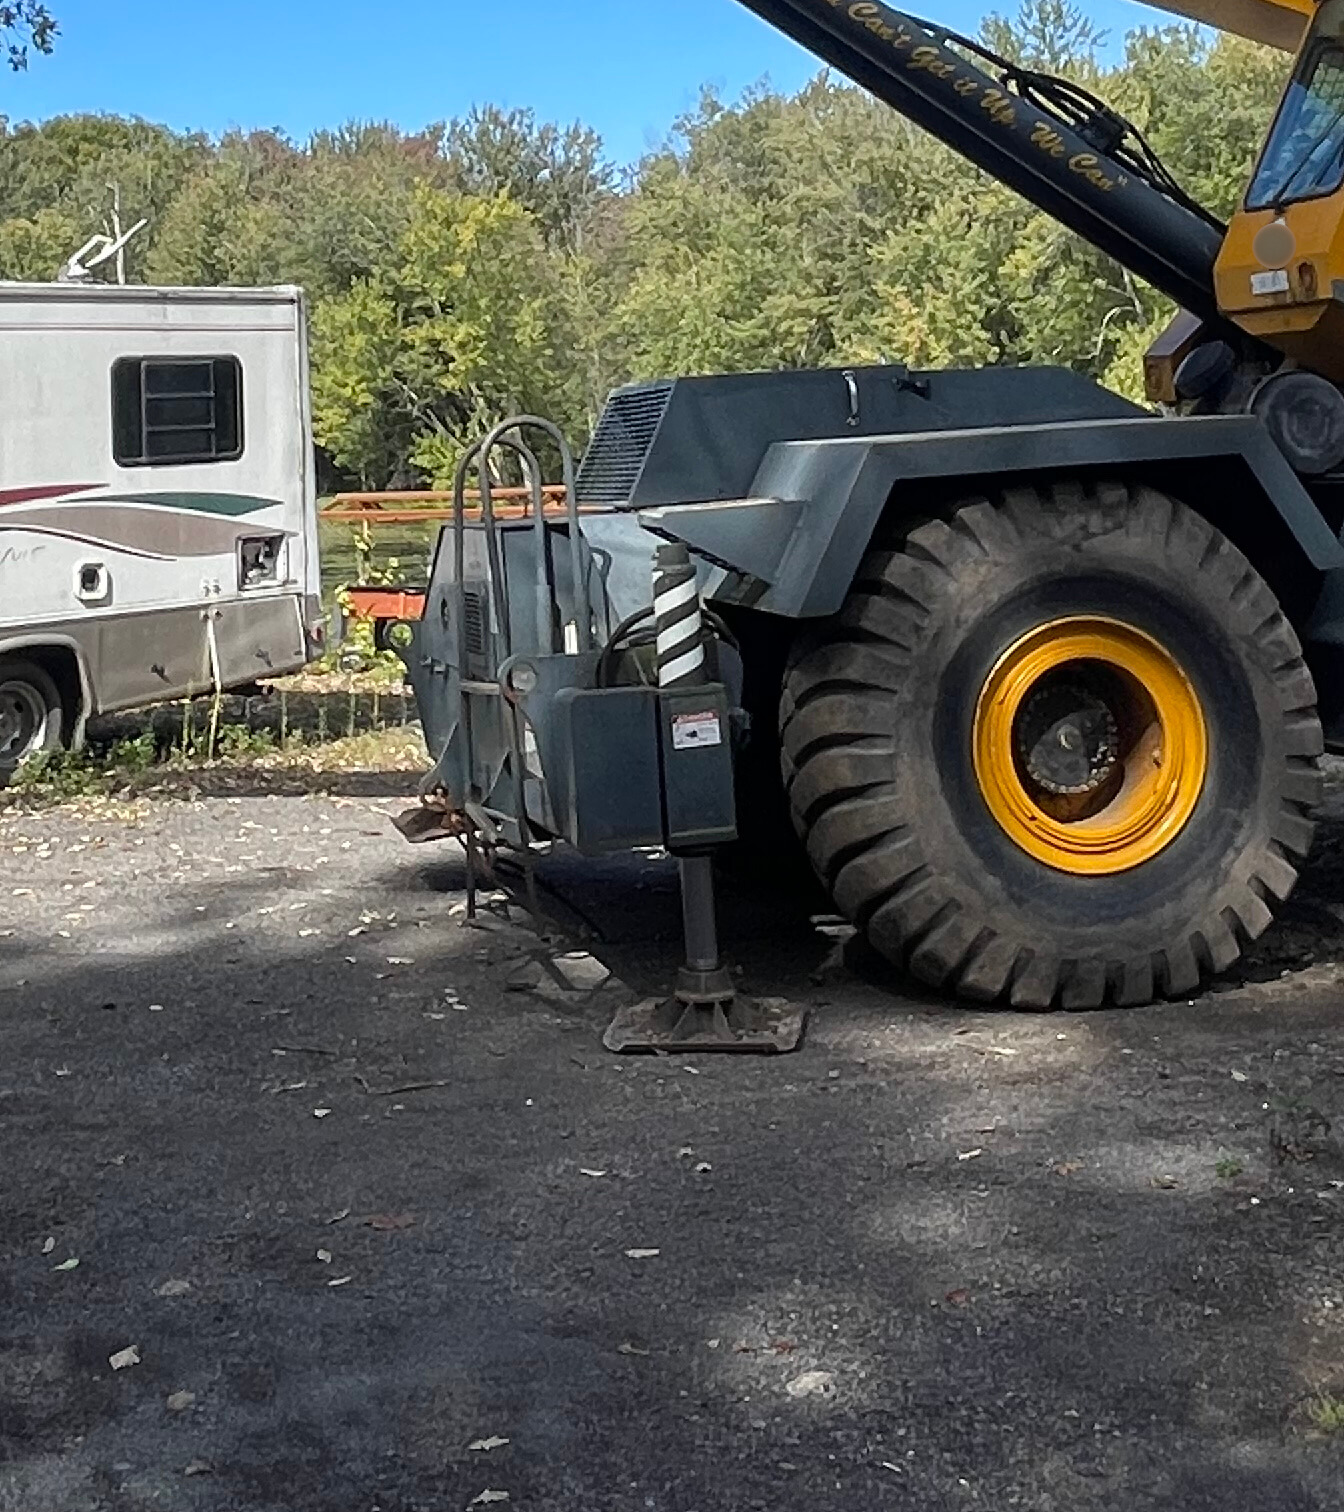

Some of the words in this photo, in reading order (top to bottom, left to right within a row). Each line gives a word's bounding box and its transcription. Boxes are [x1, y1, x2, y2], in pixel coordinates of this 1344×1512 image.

[848, 1, 912, 49] Can't
[906, 46, 956, 79] Get
[953, 76, 978, 97] it
[1030, 120, 1066, 158] We
